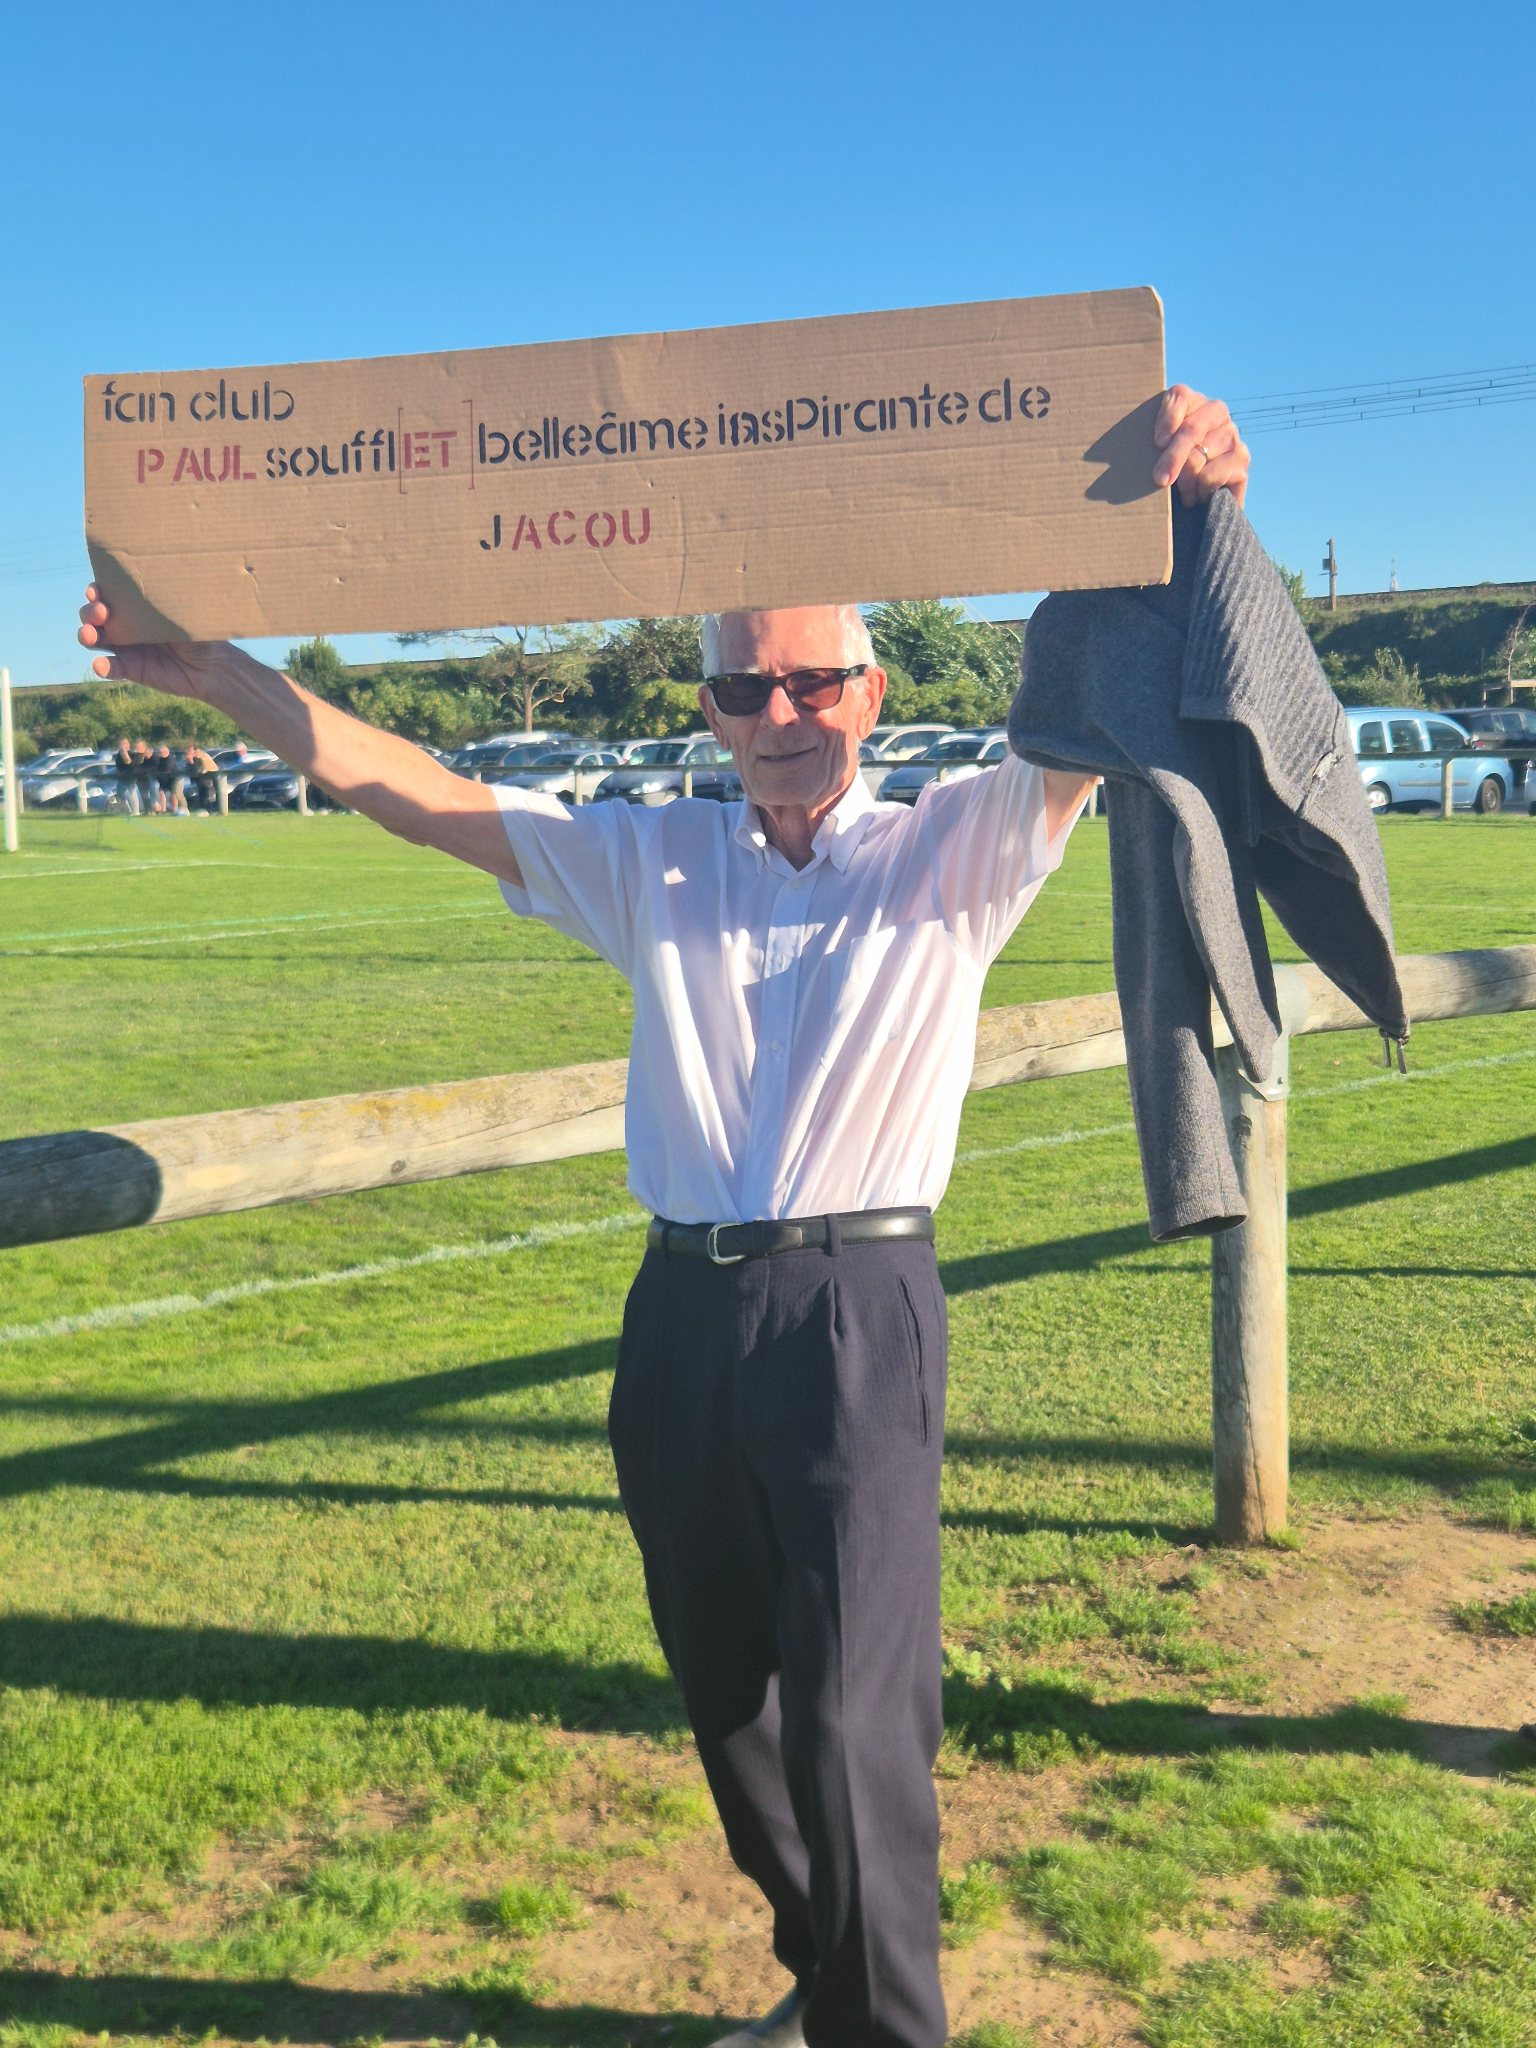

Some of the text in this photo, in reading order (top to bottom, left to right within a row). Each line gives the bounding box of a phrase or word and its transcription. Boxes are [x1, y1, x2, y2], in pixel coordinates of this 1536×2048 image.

[103, 378, 295, 423] fan club
[137, 444, 257, 484] PAUL
[479, 507, 651, 551] JACOU
